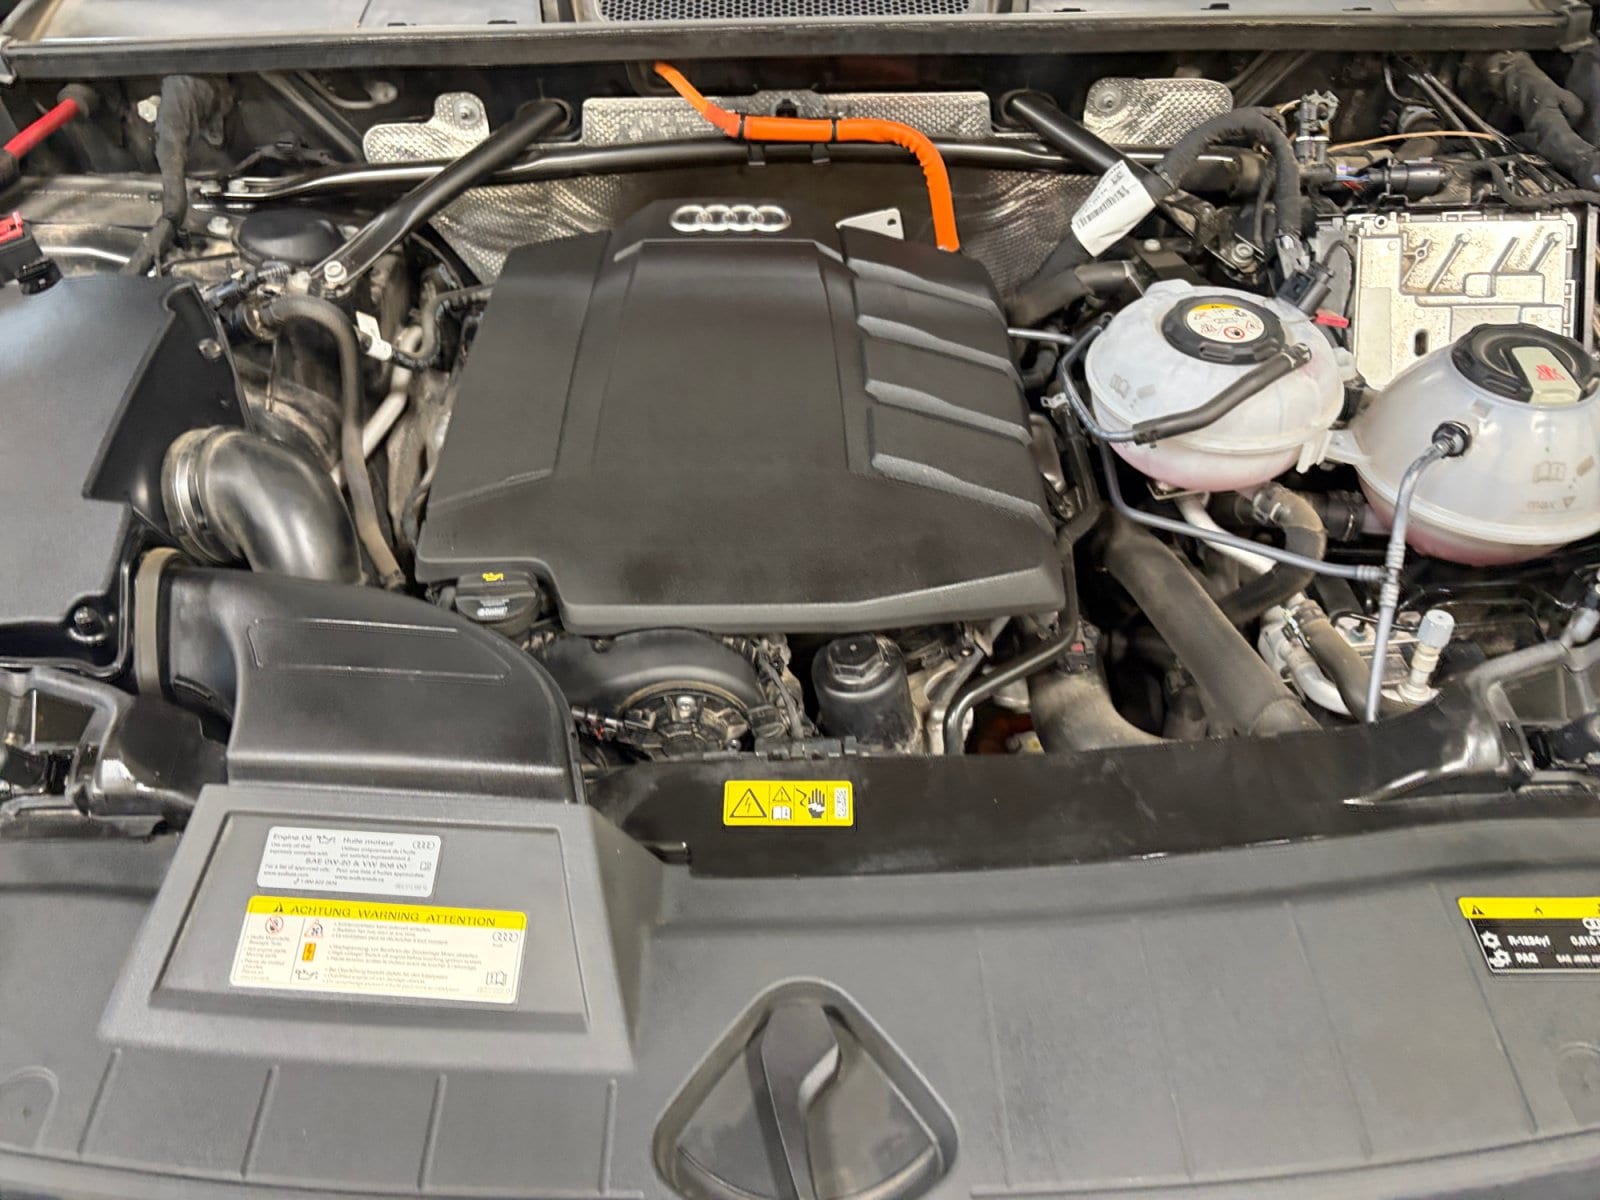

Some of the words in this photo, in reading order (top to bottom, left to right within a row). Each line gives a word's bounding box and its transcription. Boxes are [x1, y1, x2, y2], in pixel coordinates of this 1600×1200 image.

[273, 833, 299, 841] Engine
[301, 834, 312, 842] Oil
[343, 836, 362, 844] Huile
[305, 857, 323, 865] SAE
[290, 904, 351, 917] ACHTUNG
[358, 909, 419, 921] WARNING
[426, 913, 496, 927] ATTENTION
